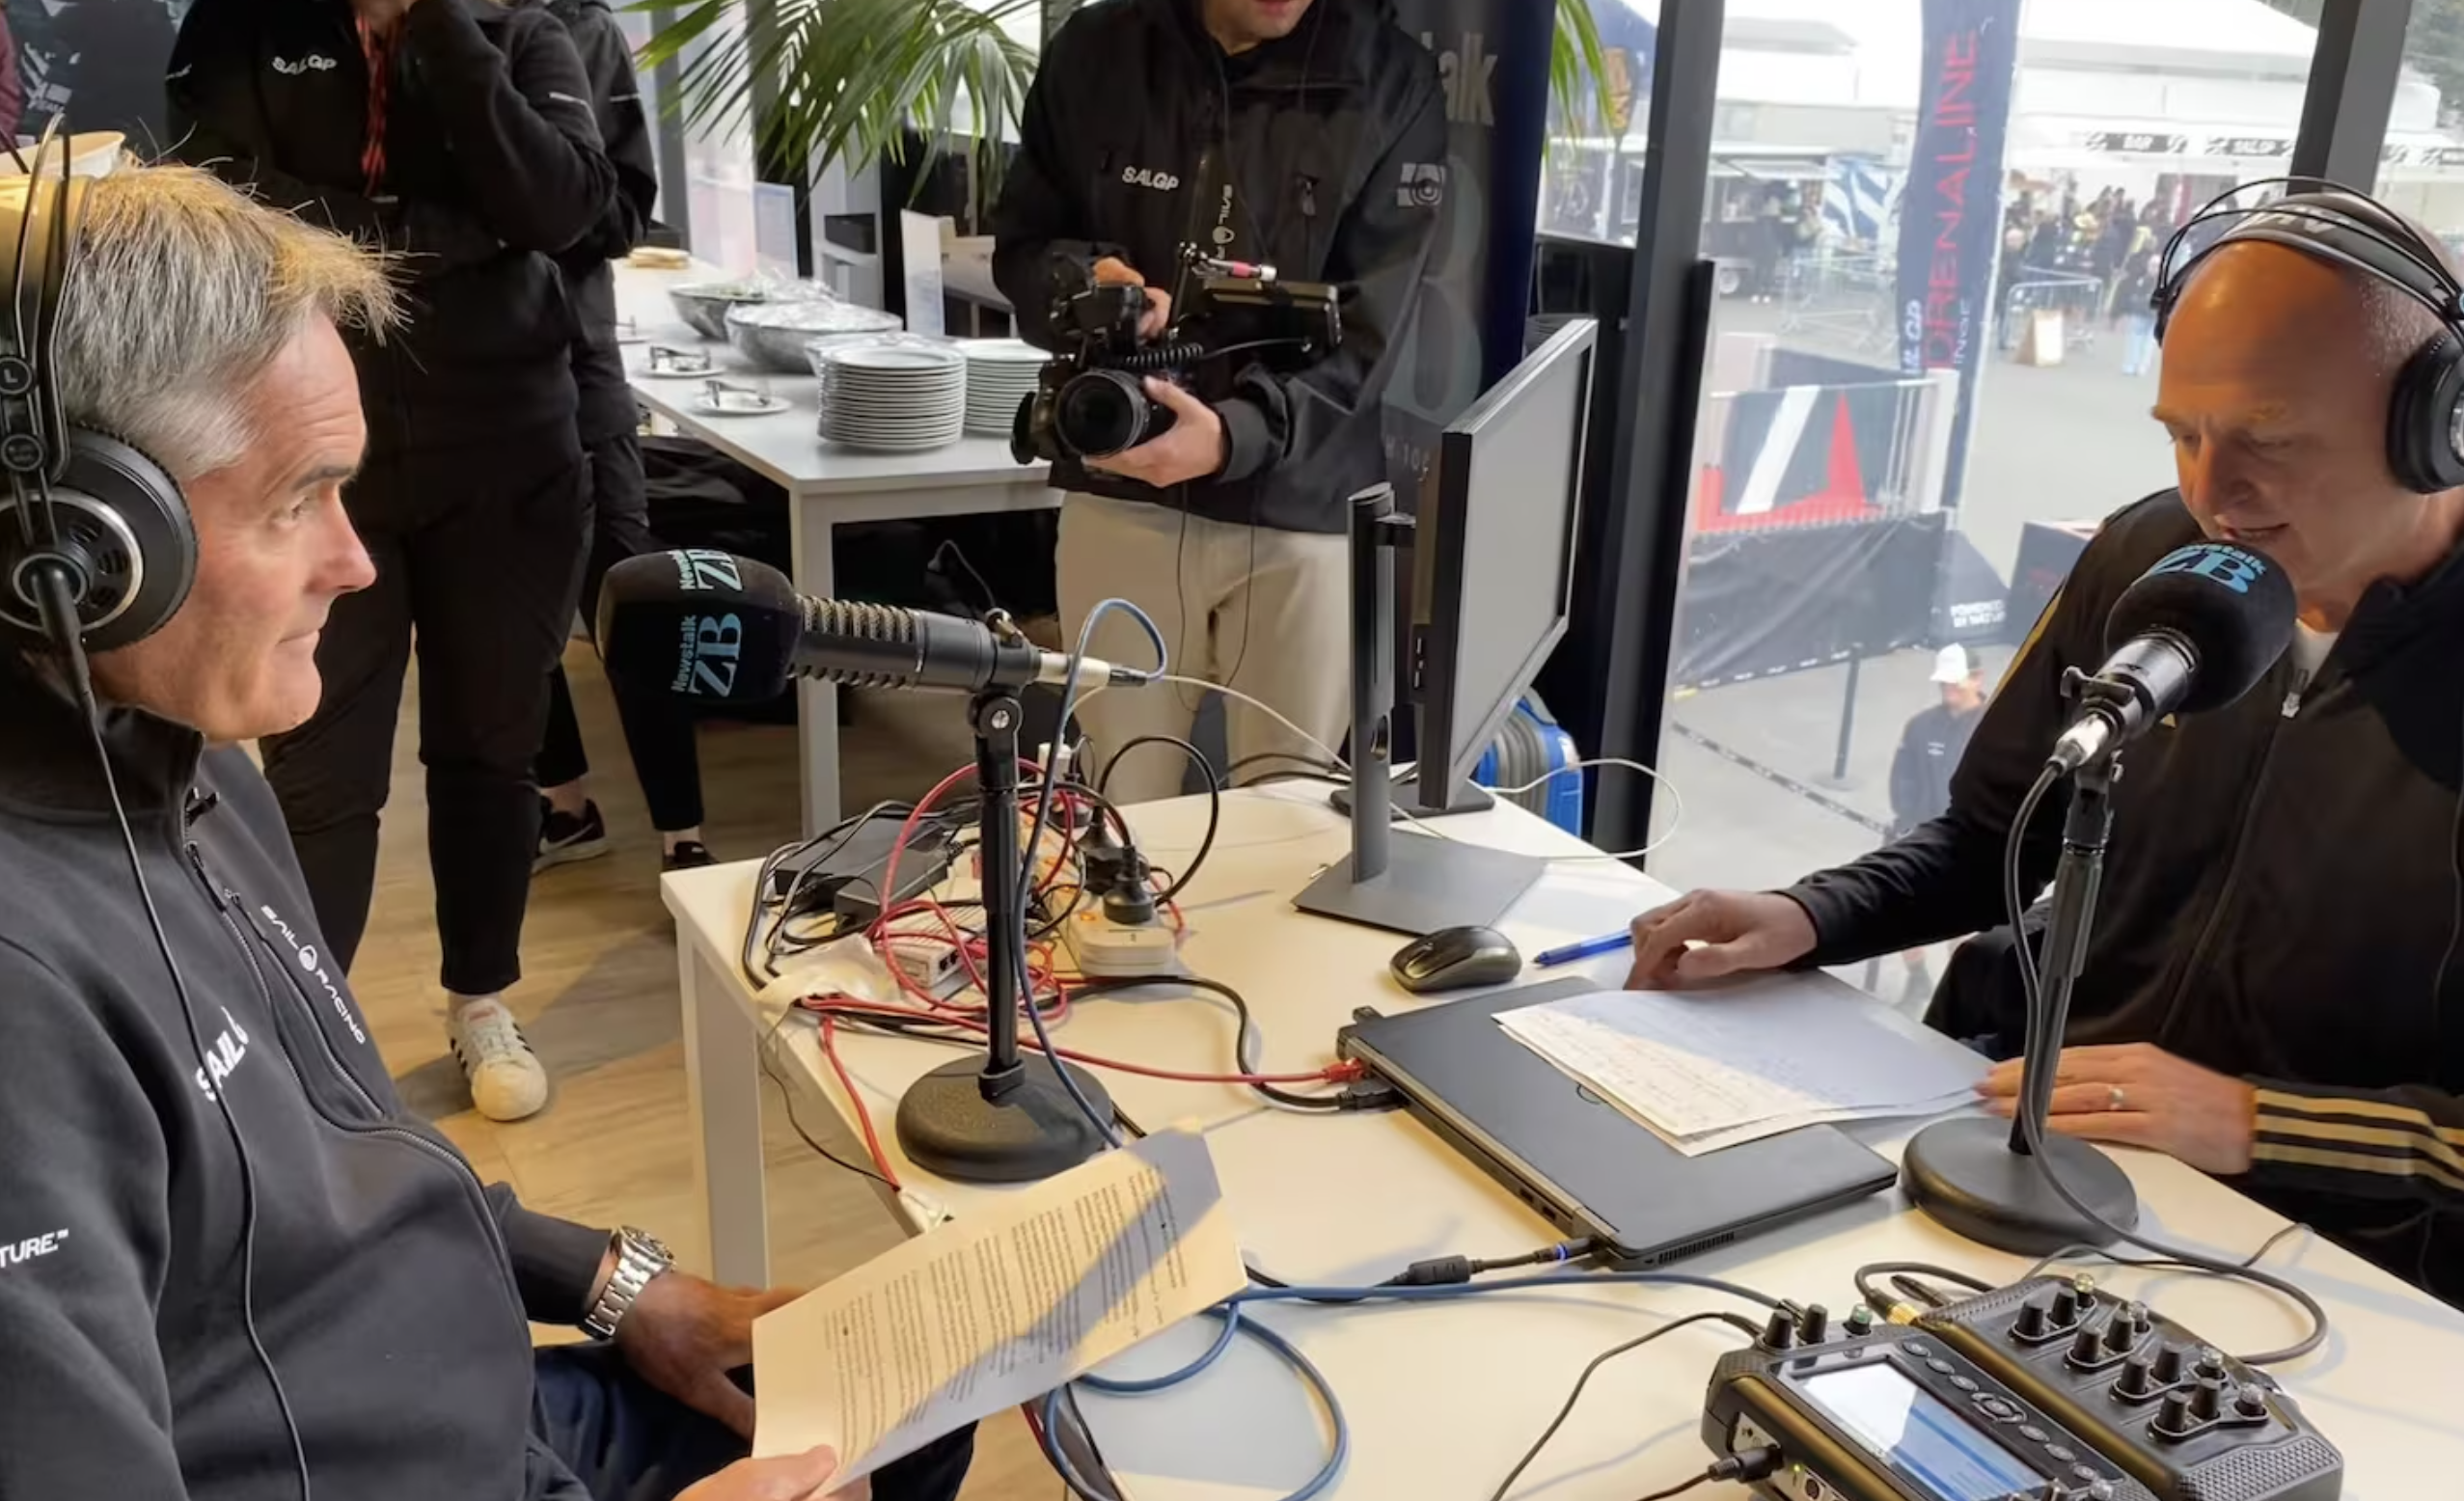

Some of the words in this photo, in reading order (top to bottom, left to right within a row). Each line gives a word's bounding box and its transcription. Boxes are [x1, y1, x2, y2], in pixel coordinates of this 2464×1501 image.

[4, 369, 18, 383] L
[2149, 550, 2257, 593] ZB
[671, 614, 698, 693] Newstalk
[687, 613, 743, 698] ZB
[315, 969, 367, 1045] RACING
